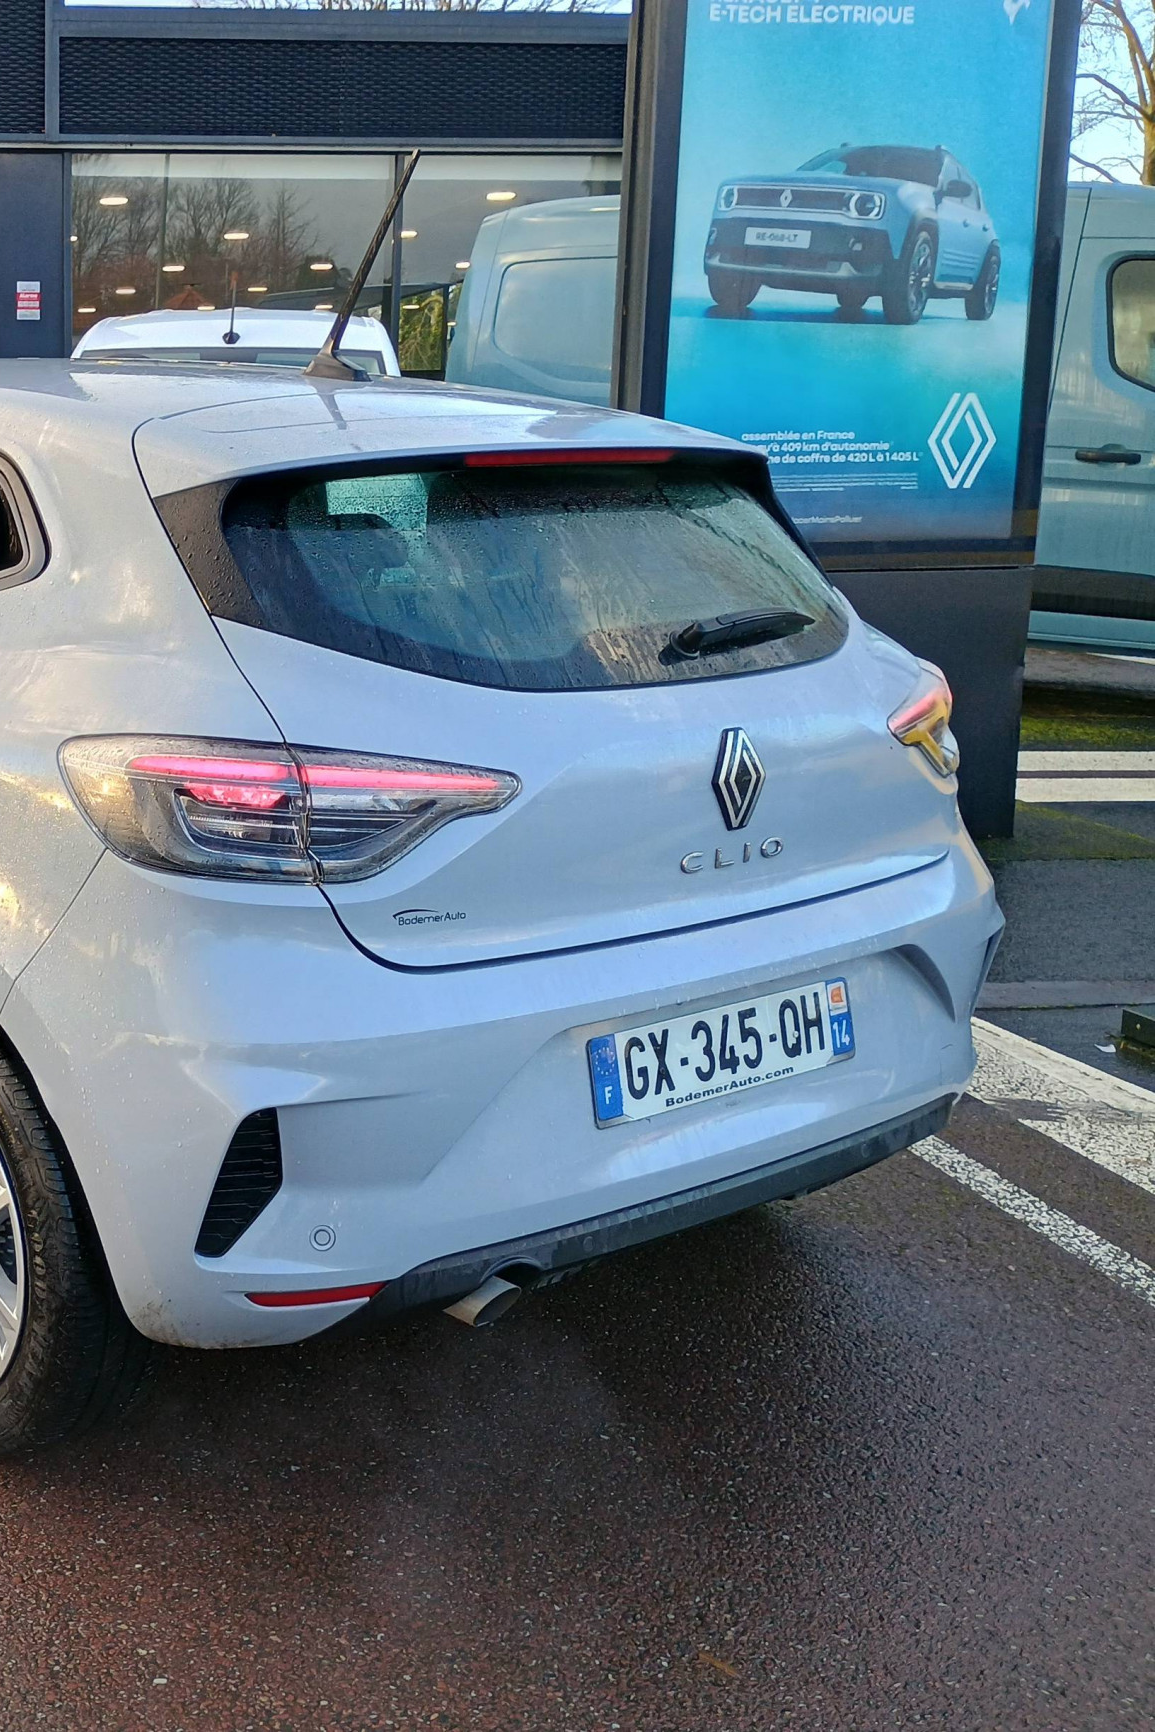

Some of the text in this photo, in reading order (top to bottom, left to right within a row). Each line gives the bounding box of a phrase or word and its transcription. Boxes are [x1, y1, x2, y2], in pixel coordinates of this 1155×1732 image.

[709, 4, 782, 24] E-TECH
[741, 429, 856, 442] assemblée en France
[780, 441, 802, 453] 409
[802, 441, 821, 452] km
[821, 440, 890, 452] d'autonomie
[781, 452, 797, 464] de
[797, 452, 832, 464] coffre
[831, 451, 847, 463] de
[847, 451, 869, 463] 420
[868, 452, 877, 463] L
[680, 836, 784, 875] CLIO
[604, 991, 851, 1105] F GX-345-QH 14
[665, 1066, 795, 1107] BodemerAuto.com
